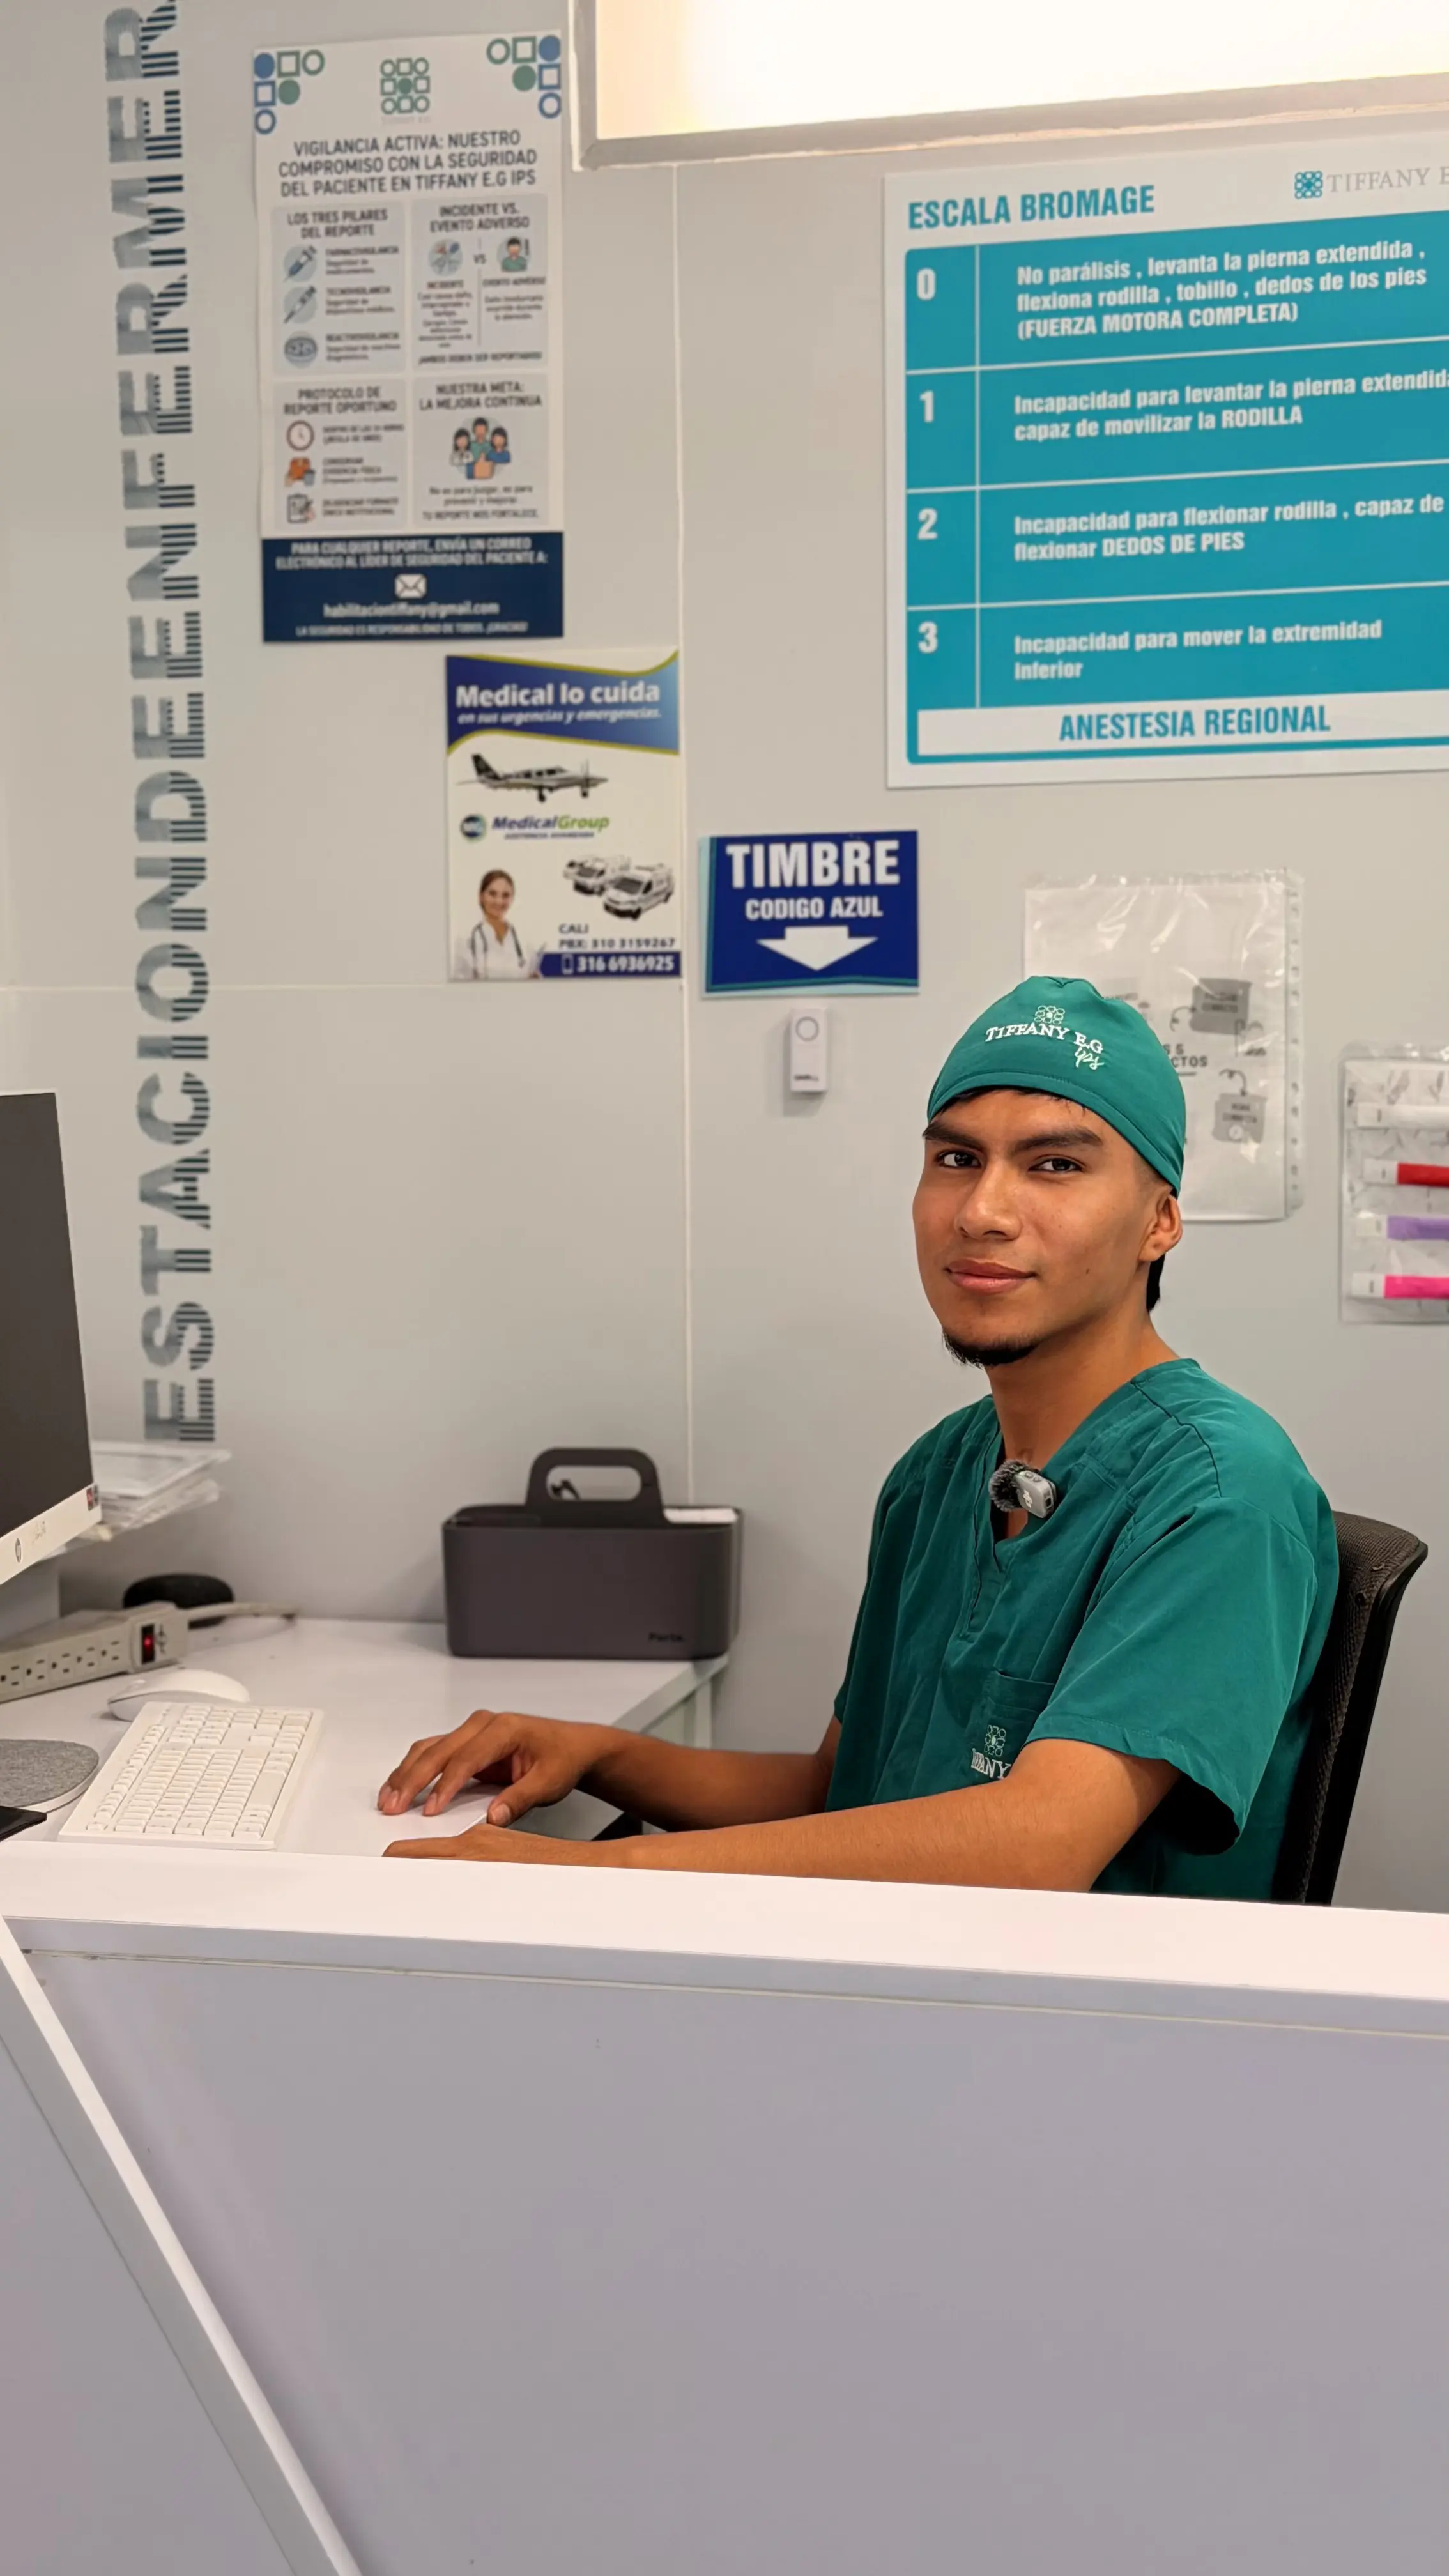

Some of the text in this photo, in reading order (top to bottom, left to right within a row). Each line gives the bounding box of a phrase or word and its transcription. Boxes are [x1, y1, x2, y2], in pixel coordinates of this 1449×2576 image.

[294, 130, 521, 157] VIGILANCIA ACTIVA: NUESTRO
[279, 149, 537, 177] COMPROMISO CON LA SEGURIDAD
[281, 169, 537, 197] DEL PACIENTE EN TIFFANY E.G IPS
[1326, 167, 1430, 192] TIFFANY
[288, 208, 388, 226] LOS TRES PILARES
[440, 203, 498, 217] INCIDENTE
[908, 185, 1154, 229] ESCALA BROMAGE
[301, 224, 374, 239] DEL REPORTE
[430, 217, 530, 233] EVENTO ADVERSO
[1017, 240, 1413, 286] No parálisis levanta la pierna extendida
[916, 268, 936, 300] 0
[1017, 268, 1427, 312] flexiona rodilla tobillo dedos de los pies
[1018, 302, 1298, 341] (FUERZA MOTORA COMPLETA)
[298, 385, 380, 400] PROTOCOLO DE
[419, 394, 542, 411] LA MEJORA CONTINUA
[436, 383, 487, 395] NUESTRA
[1014, 369, 1449, 415] Incapacidad para levantar la pierna extendid
[284, 400, 397, 415] REPORTE OPORTUNO
[919, 390, 934, 423] 1
[1014, 405, 1303, 441] capaz de movilizar la RODILLA
[917, 507, 937, 540] 2
[1014, 494, 1444, 536] Incapacidad para flexionar rodilla capaz de
[291, 542, 319, 555] PARA
[1014, 532, 1245, 562] flexionar DEDOS DE PIES
[918, 621, 938, 654] 3
[1014, 619, 1382, 654] Incapacidad para mover la extremidad
[456, 680, 659, 708] Medical lo cuida
[457, 713, 475, 724] en
[477, 712, 498, 723] sus
[500, 709, 563, 726] urgencias
[564, 711, 574, 724] y
[1059, 705, 1331, 741] ANESTESIA REGIONAL
[726, 839, 900, 889] TIMBRE
[745, 896, 883, 921] CODIGO AZUL
[558, 924, 589, 934] CALI
[577, 955, 606, 972] 316
[985, 1022, 1104, 1054] TIFFANY E.G
